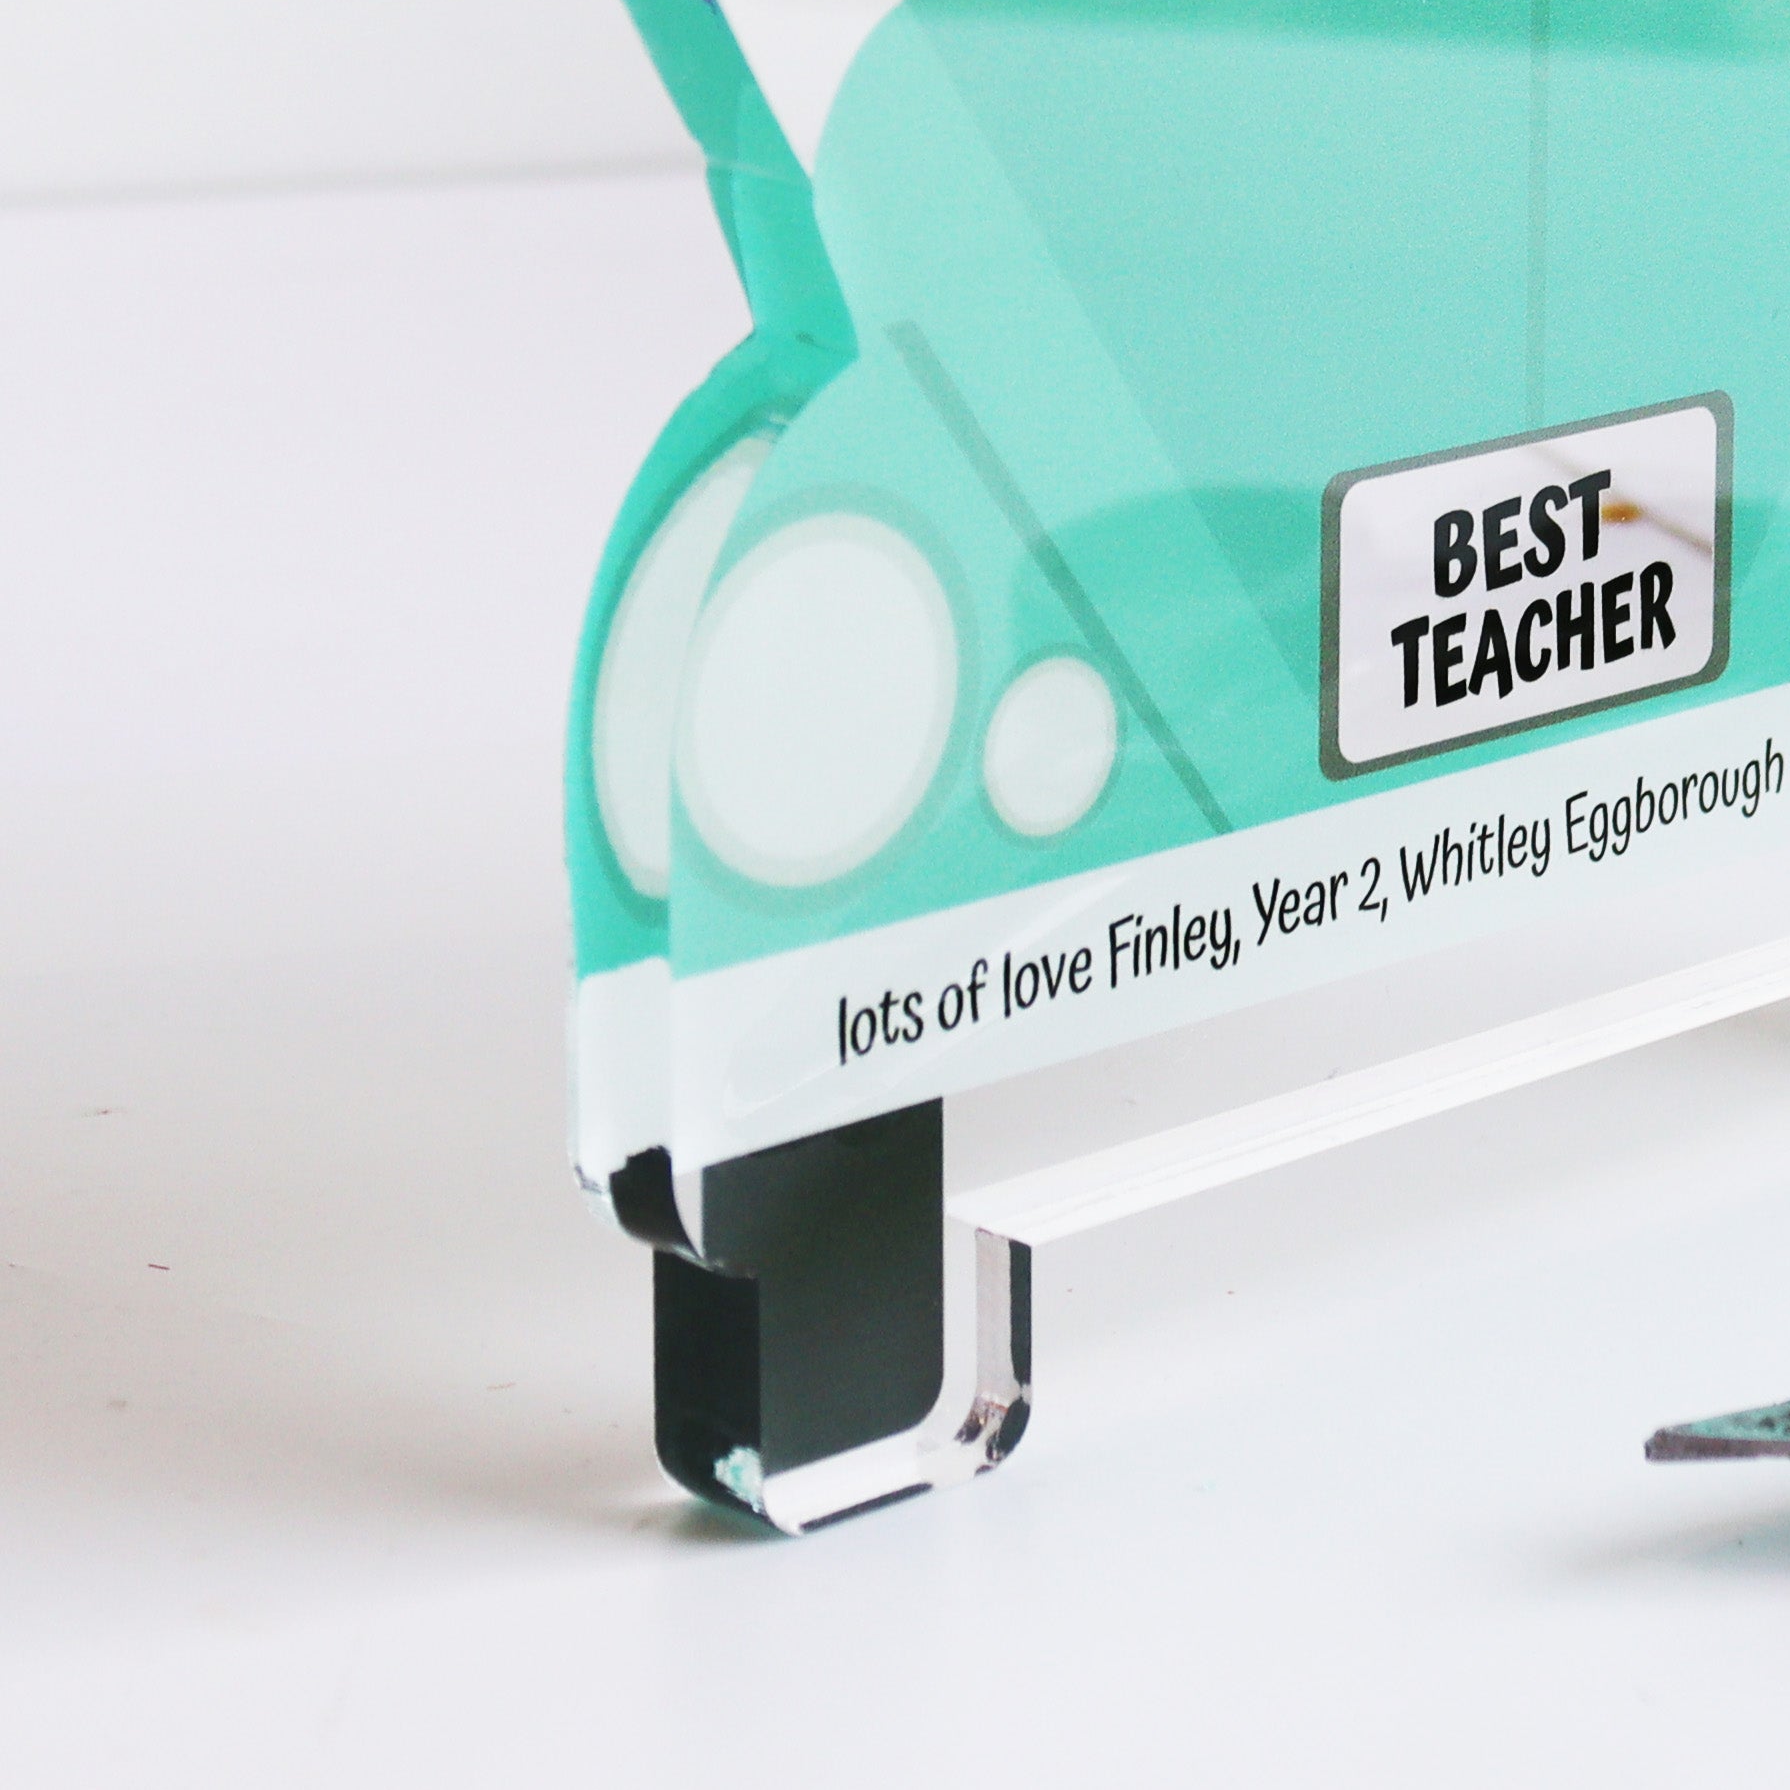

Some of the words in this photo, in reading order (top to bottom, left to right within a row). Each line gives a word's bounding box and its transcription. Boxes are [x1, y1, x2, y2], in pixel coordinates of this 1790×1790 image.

[1433, 469, 1612, 599] BEST
[1390, 560, 1677, 709] TEACHER
[838, 990, 924, 1065] lots
[937, 958, 988, 1031] of
[1003, 947, 1092, 1018] love
[1108, 904, 1241, 989] Finley,
[1252, 871, 1349, 946] Year
[1358, 857, 1388, 922] 2,
[1399, 814, 1551, 902] Whitley
[1565, 738, 1784, 863] Eggborough
